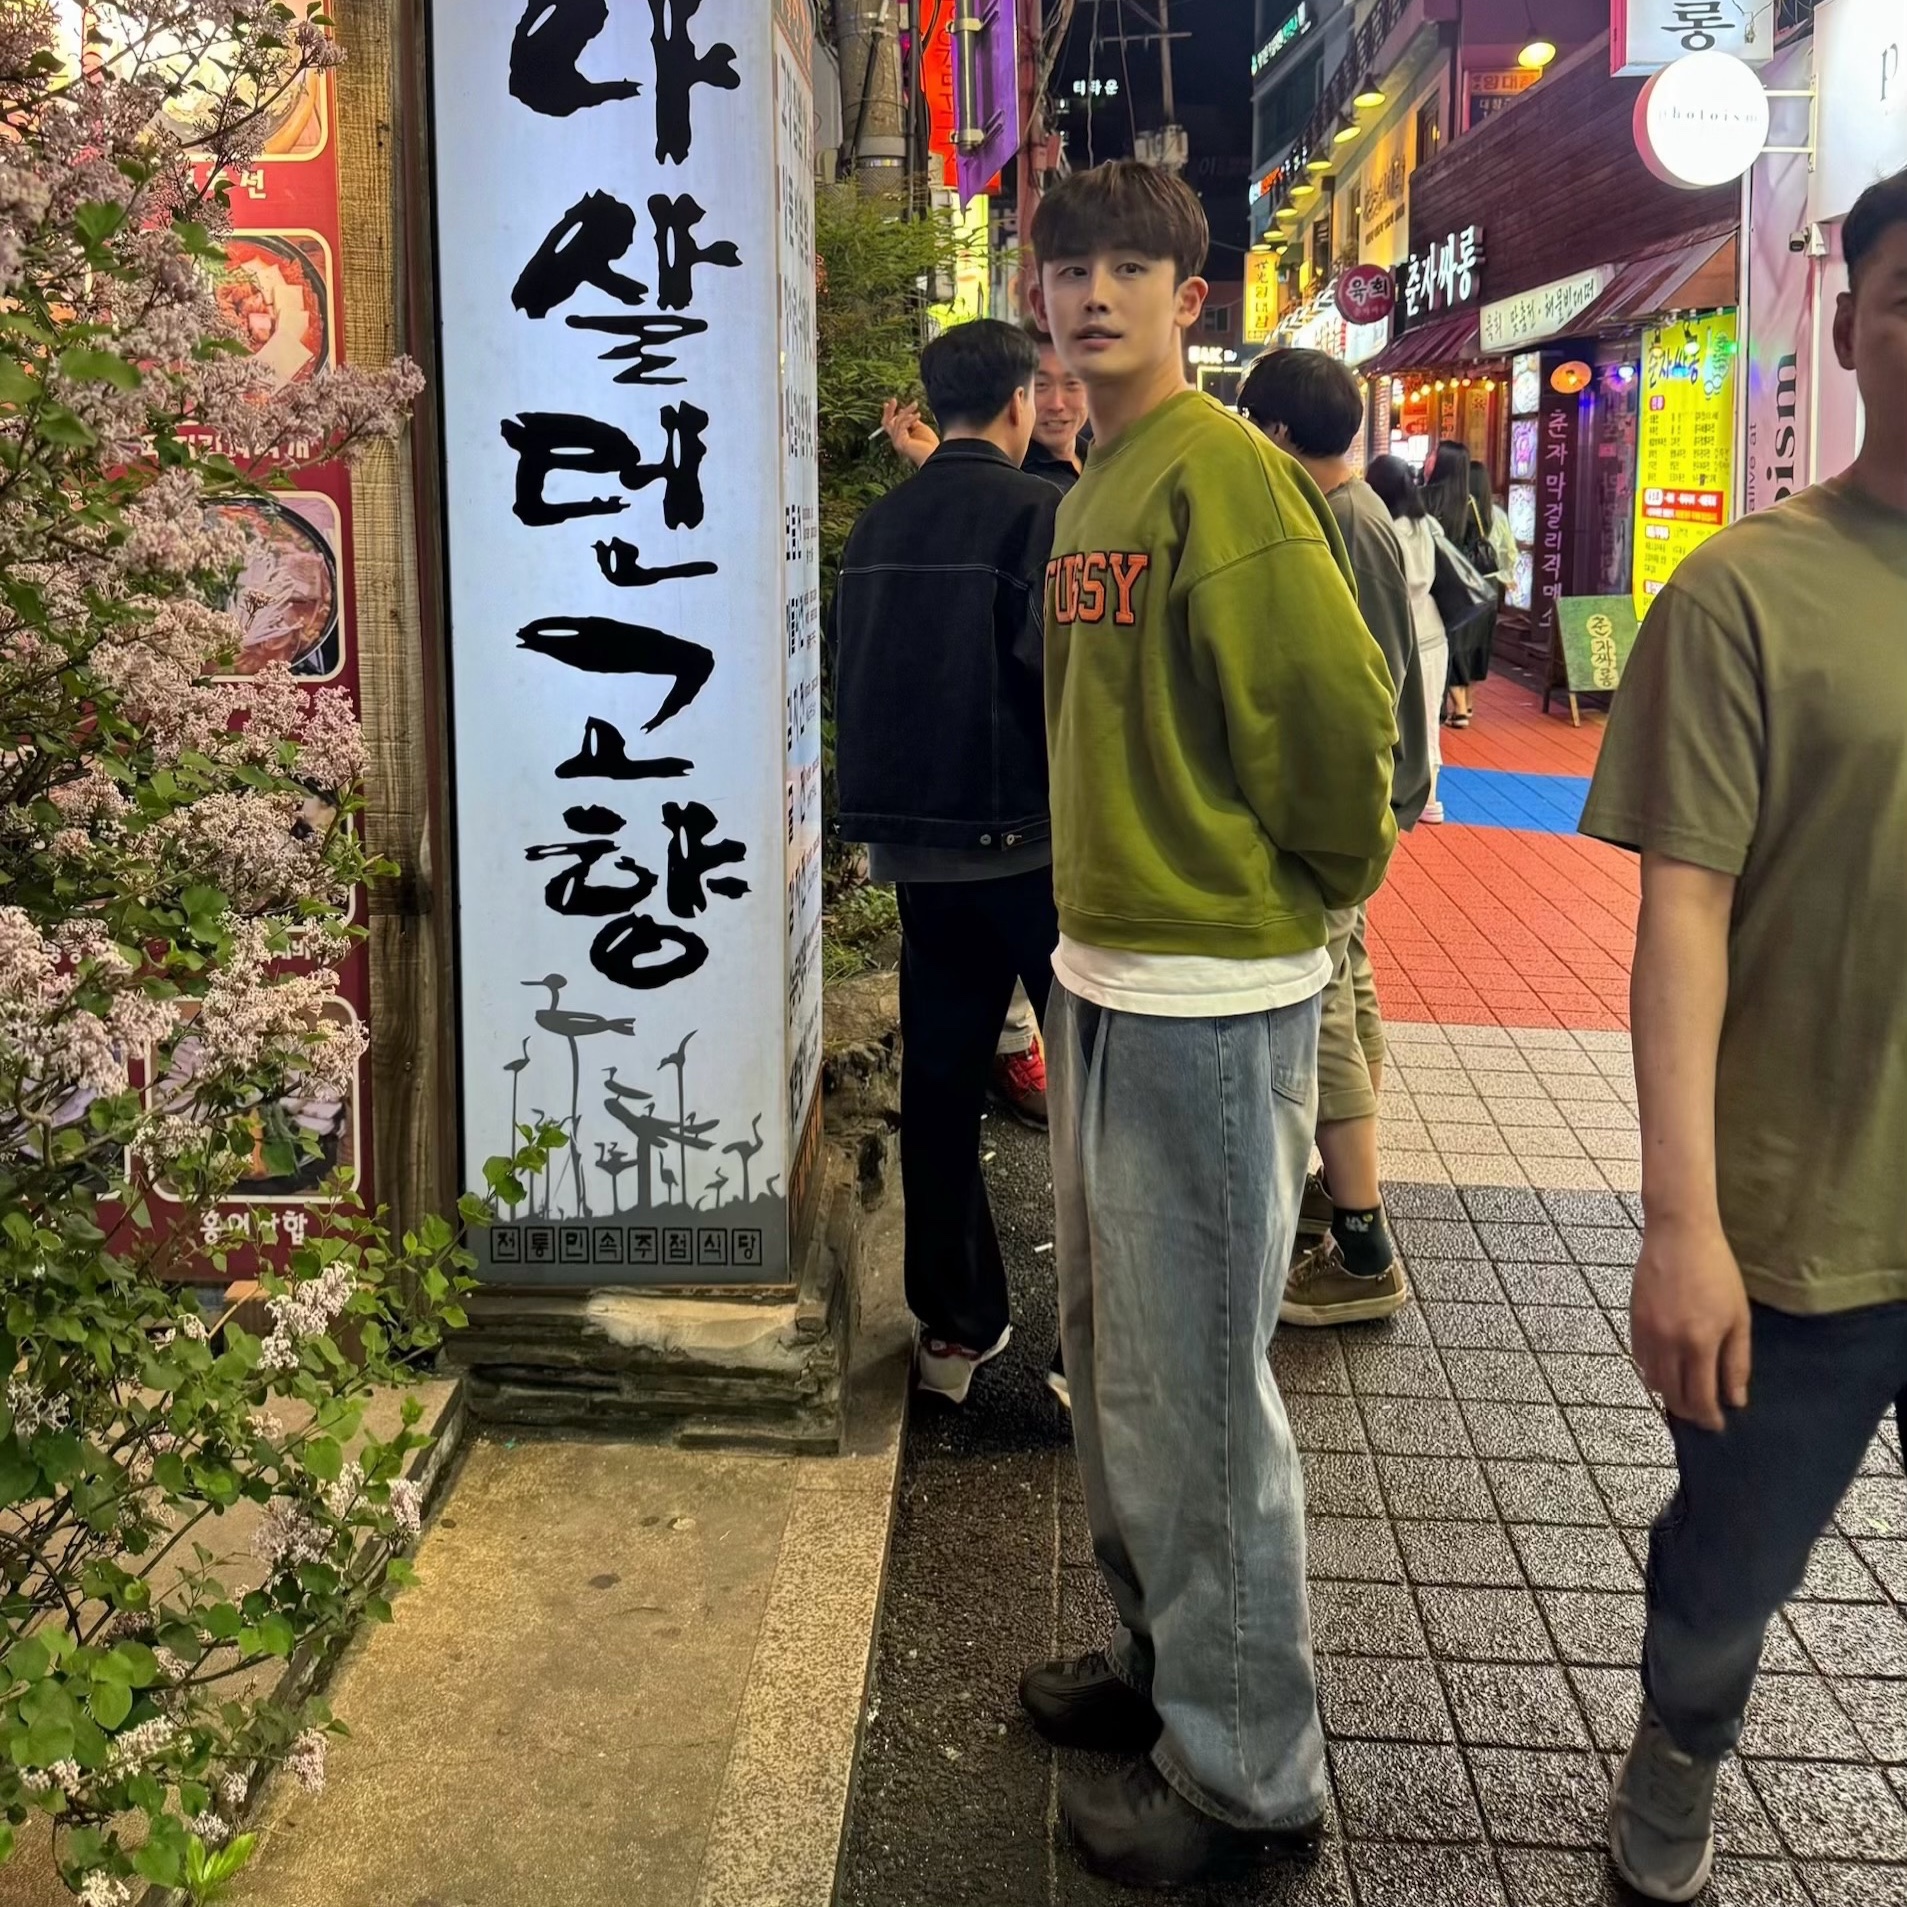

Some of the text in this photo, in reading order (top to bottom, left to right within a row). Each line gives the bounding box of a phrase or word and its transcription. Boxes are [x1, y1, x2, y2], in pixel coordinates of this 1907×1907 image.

[1661, 1, 1736, 51] 롱
[1658, 105, 1758, 122] photoism
[1404, 225, 1478, 317] 춘자싸롱
[1347, 276, 1389, 304] 육회
[1484, 310, 1502, 342] 육회
[1749, 422, 1757, 446] at
[496, 1231, 757, 1261] 전통민속주점식당
